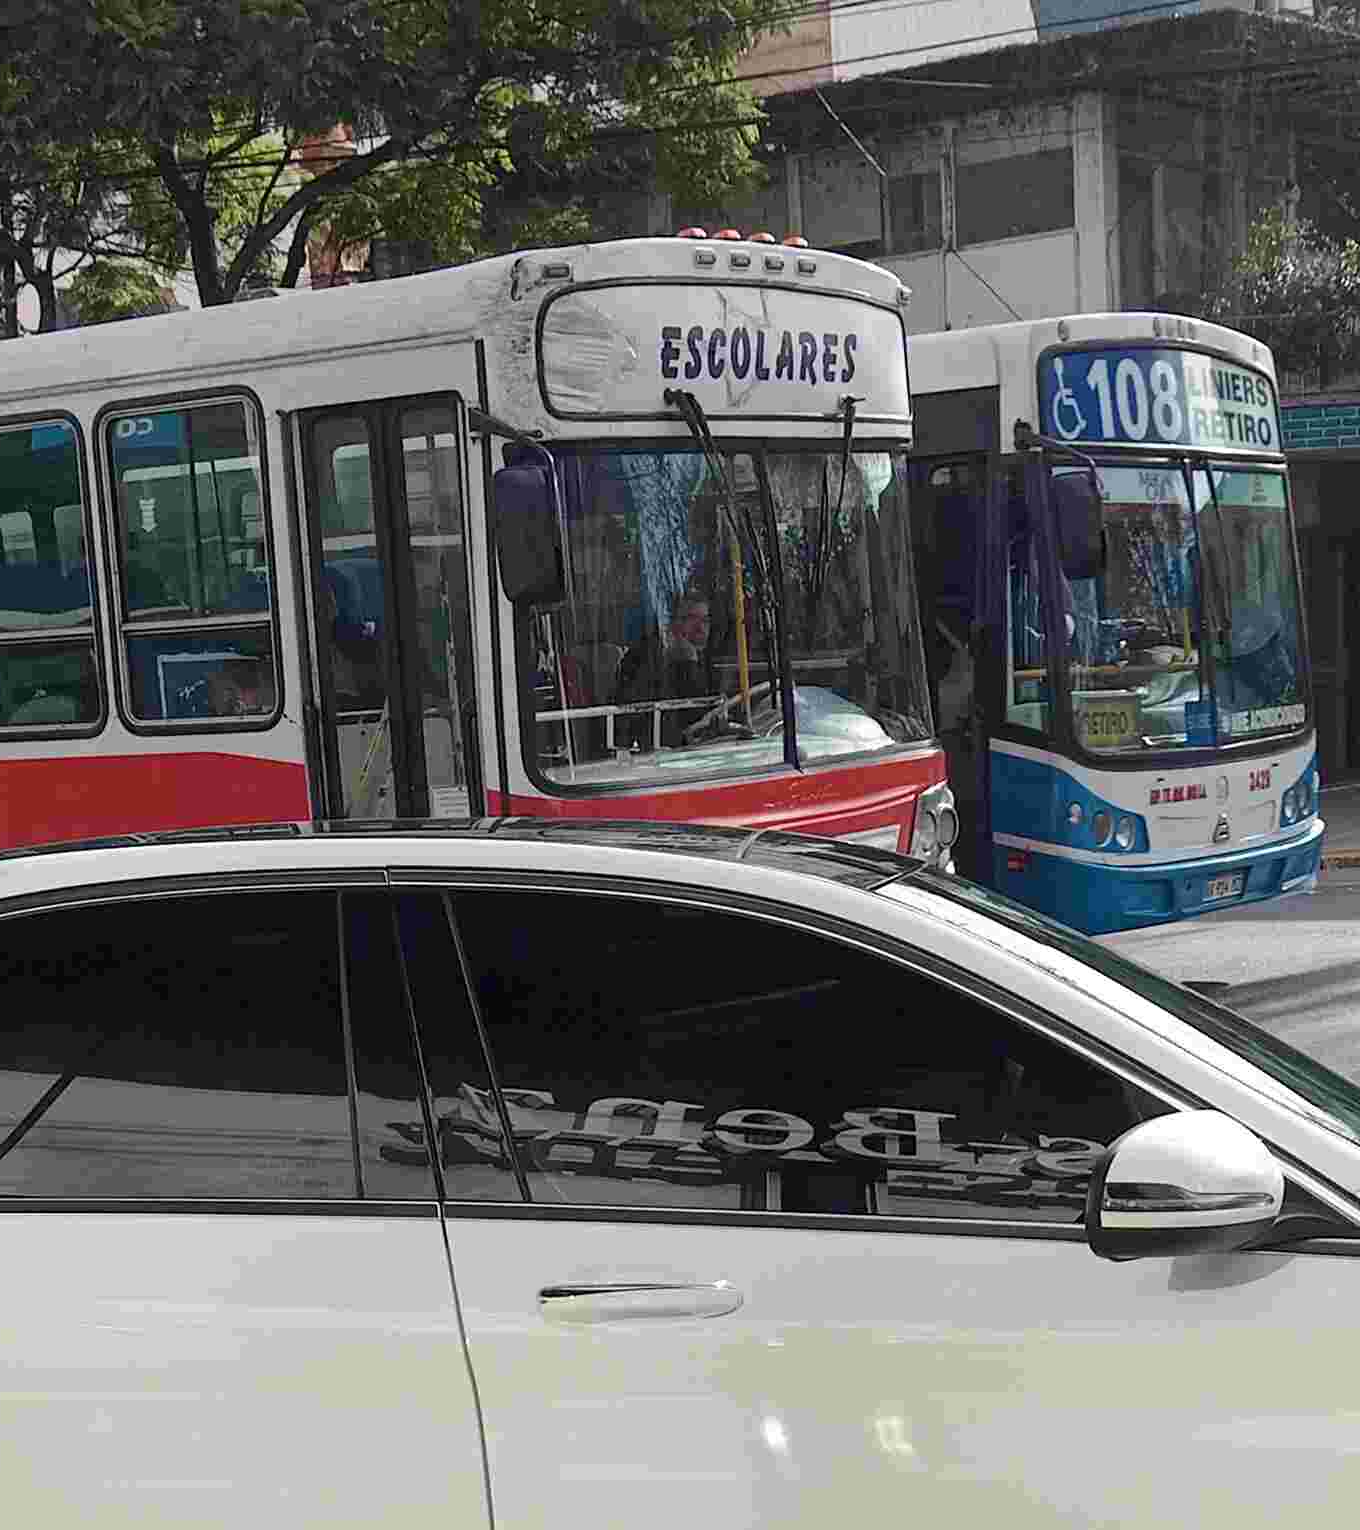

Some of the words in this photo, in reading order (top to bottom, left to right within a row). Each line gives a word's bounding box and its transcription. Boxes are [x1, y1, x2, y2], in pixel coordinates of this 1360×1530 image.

[660, 326, 858, 385] ESCOLARES
[1086, 359, 1183, 440] 108
[1188, 360, 1269, 407] LINIERS
[1192, 407, 1273, 447] RETIRO
